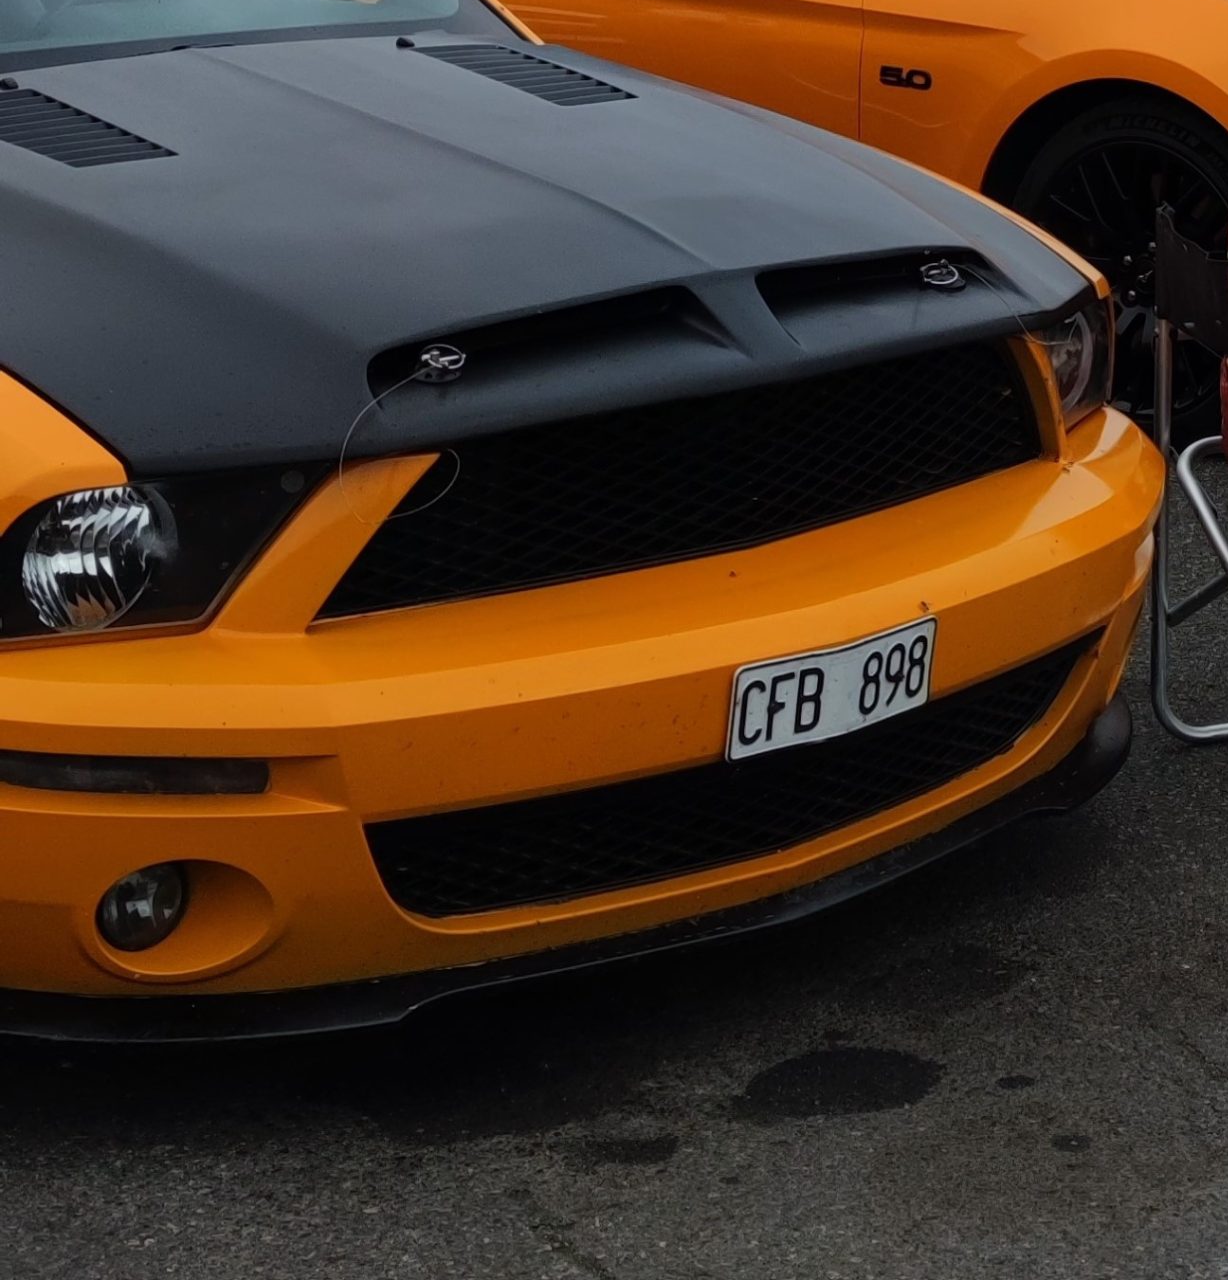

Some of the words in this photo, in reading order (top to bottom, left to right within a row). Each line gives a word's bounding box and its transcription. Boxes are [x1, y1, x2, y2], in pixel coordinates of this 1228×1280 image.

[879, 64, 933, 91] 5.0
[738, 667, 825, 746] CFB
[858, 634, 928, 716] 898
